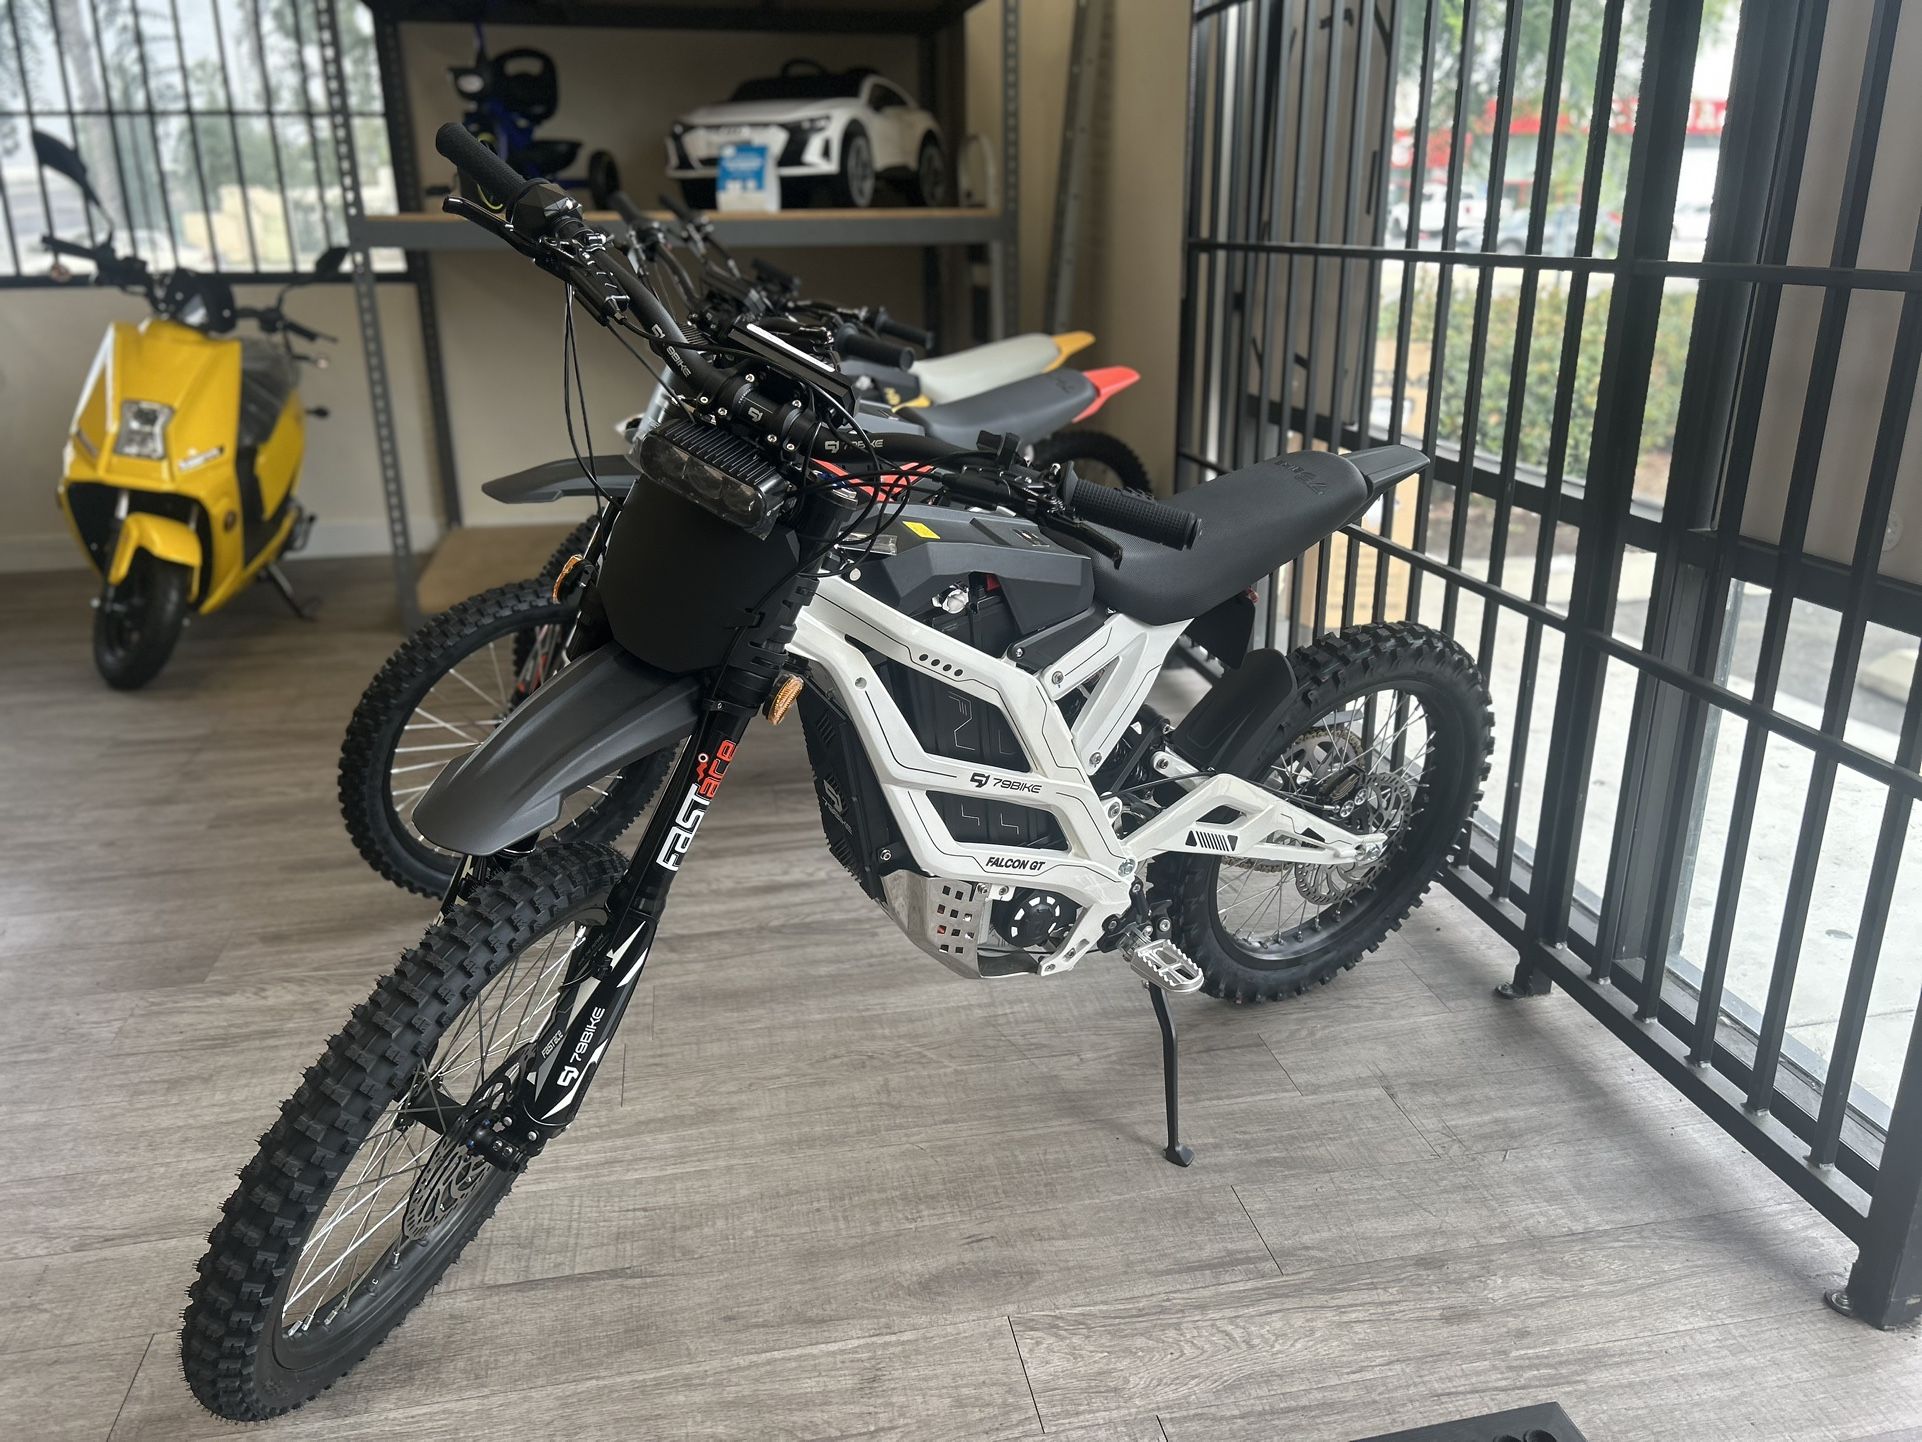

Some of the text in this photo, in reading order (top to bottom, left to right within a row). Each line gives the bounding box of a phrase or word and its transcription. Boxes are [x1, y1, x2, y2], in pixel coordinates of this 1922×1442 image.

[663, 342, 692, 378] 9BIKE
[993, 777, 1043, 793] 79BIKE
[985, 856, 1046, 871] FALCON GT
[569, 1006, 606, 1063] 79BIKE
